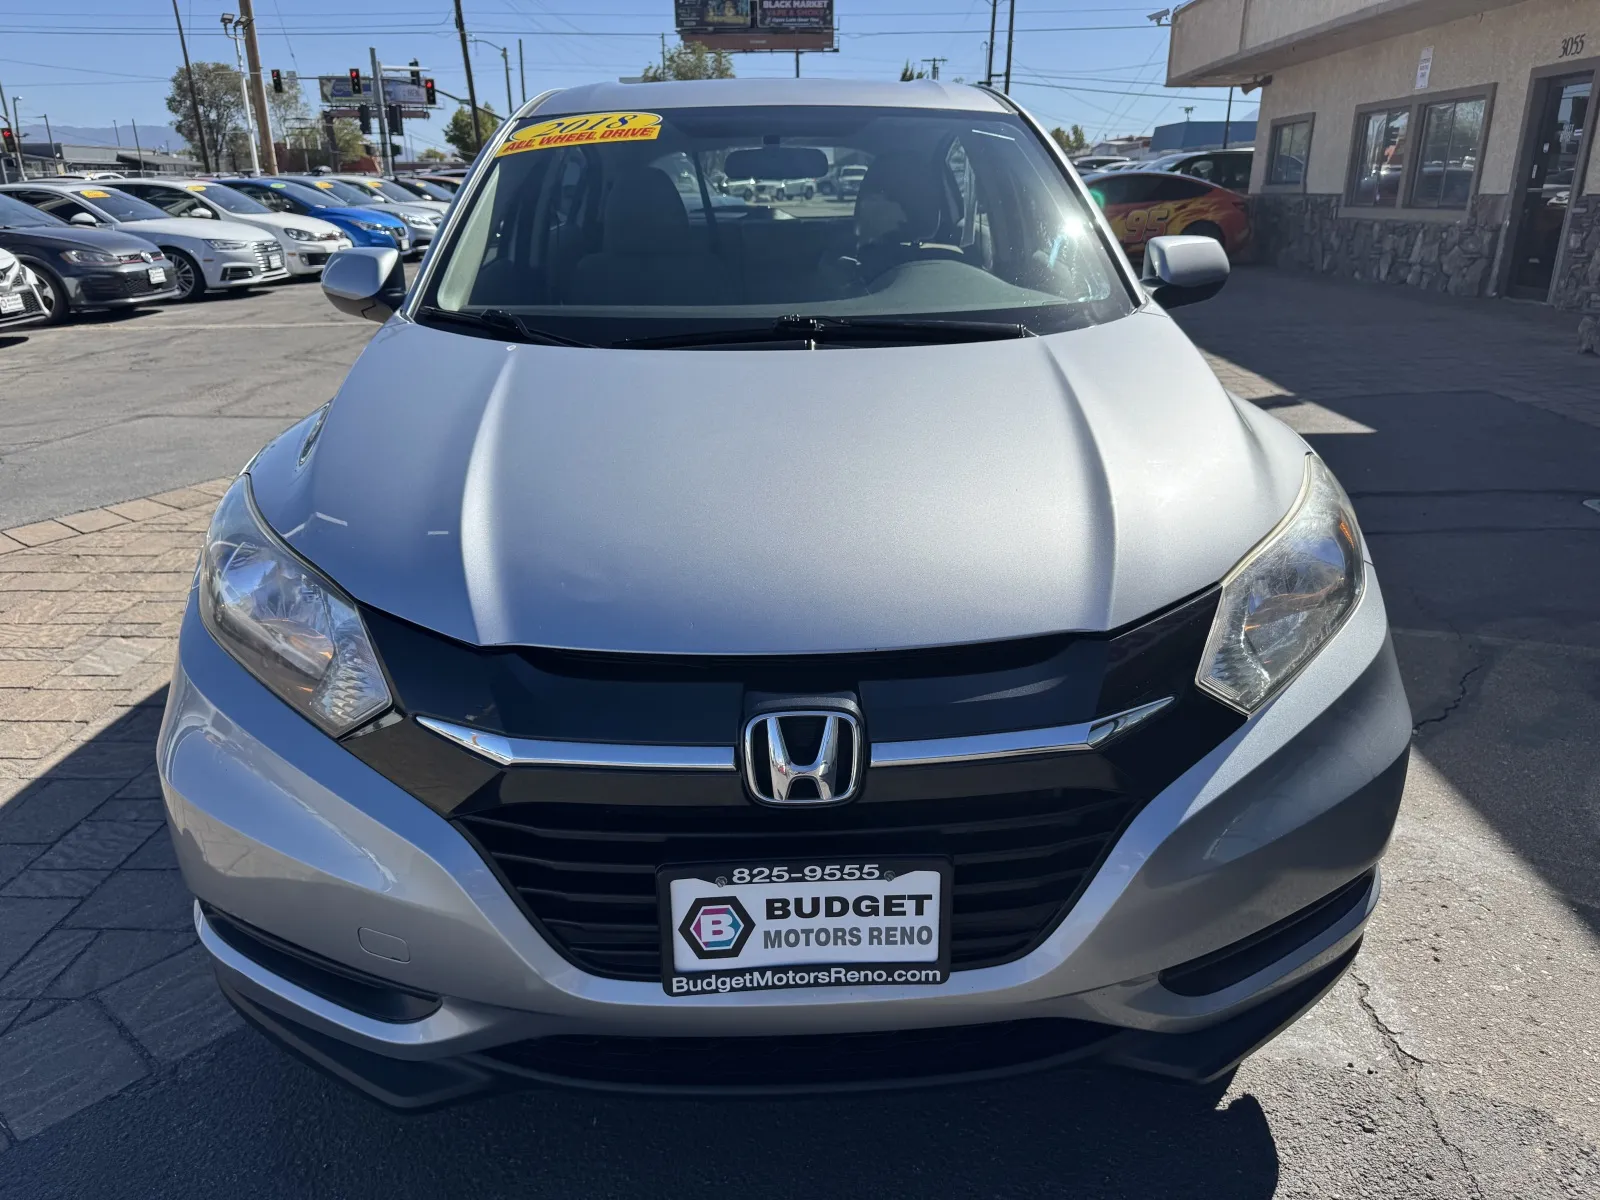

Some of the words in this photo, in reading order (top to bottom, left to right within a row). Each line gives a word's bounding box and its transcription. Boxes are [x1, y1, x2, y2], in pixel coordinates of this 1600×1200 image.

[763, 0, 791, 8] BLACK
[793, 0, 829, 8] MARKET
[1558, 33, 1586, 59] 3055
[532, 114, 638, 138] 2018
[503, 139, 534, 152] ALL
[538, 130, 598, 147] WHEEL
[599, 127, 654, 139] DRIVE
[1123, 209, 1170, 244] 95
[732, 864, 880, 884] 825-9555
[765, 894, 933, 920] BUDGET
[763, 926, 862, 949] MOTORS
[868, 925, 933, 946] RENO
[671, 967, 941, 993] BudgetMotorsReno.com
